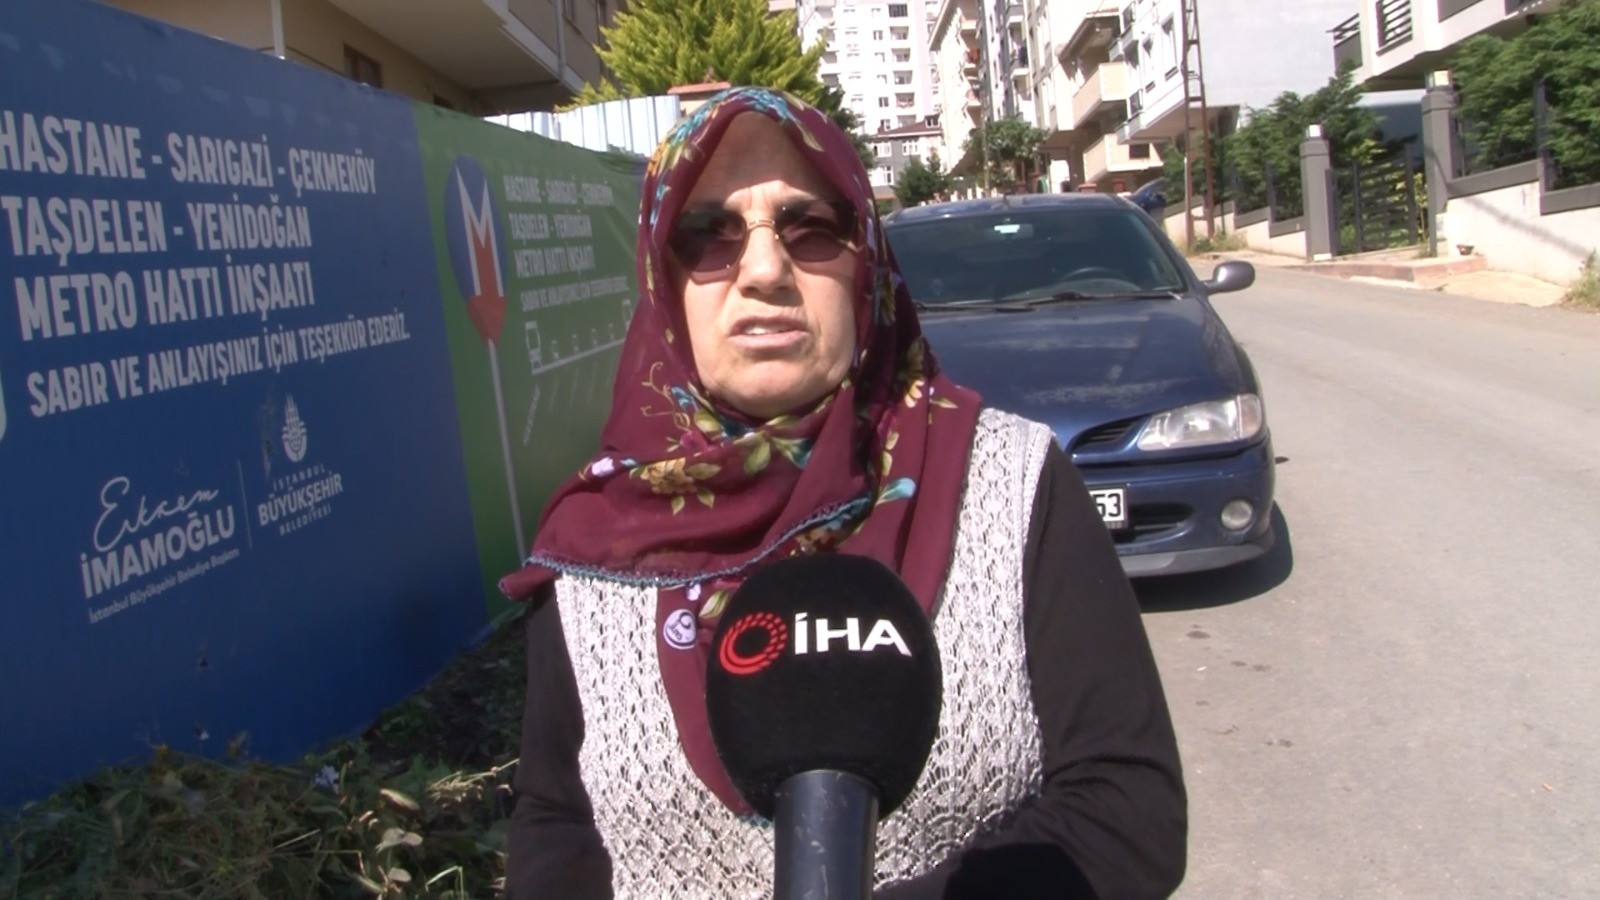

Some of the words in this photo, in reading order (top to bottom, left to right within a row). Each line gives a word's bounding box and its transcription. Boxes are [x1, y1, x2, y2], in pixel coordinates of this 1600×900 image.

[0, 110, 146, 180] HASTANE
[167, 134, 274, 188] SARIGAZİ
[288, 148, 377, 198] ÇEKMEKÖY
[2, 195, 168, 267] TAŞDELEN
[187, 193, 313, 251] YENİDOĞAN
[14, 270, 138, 342] METRO
[142, 266, 222, 326] HATTI
[226, 254, 316, 321] İNŞAATI
[26, 361, 110, 419] SABIR
[111, 355, 144, 400] VE
[147, 335, 264, 394] ANLAYIŞINIZ
[262, 325, 298, 374] İÇİN
[298, 314, 367, 364] TEŞEKKÜR
[368, 307, 411, 347] EDERİZ.
[257, 468, 344, 527] BÜYÜKŞEHİR
[272, 462, 326, 492] İSTANBUL
[80, 504, 235, 599] İMAMOĞLU
[793, 612, 913, 657] İHA
